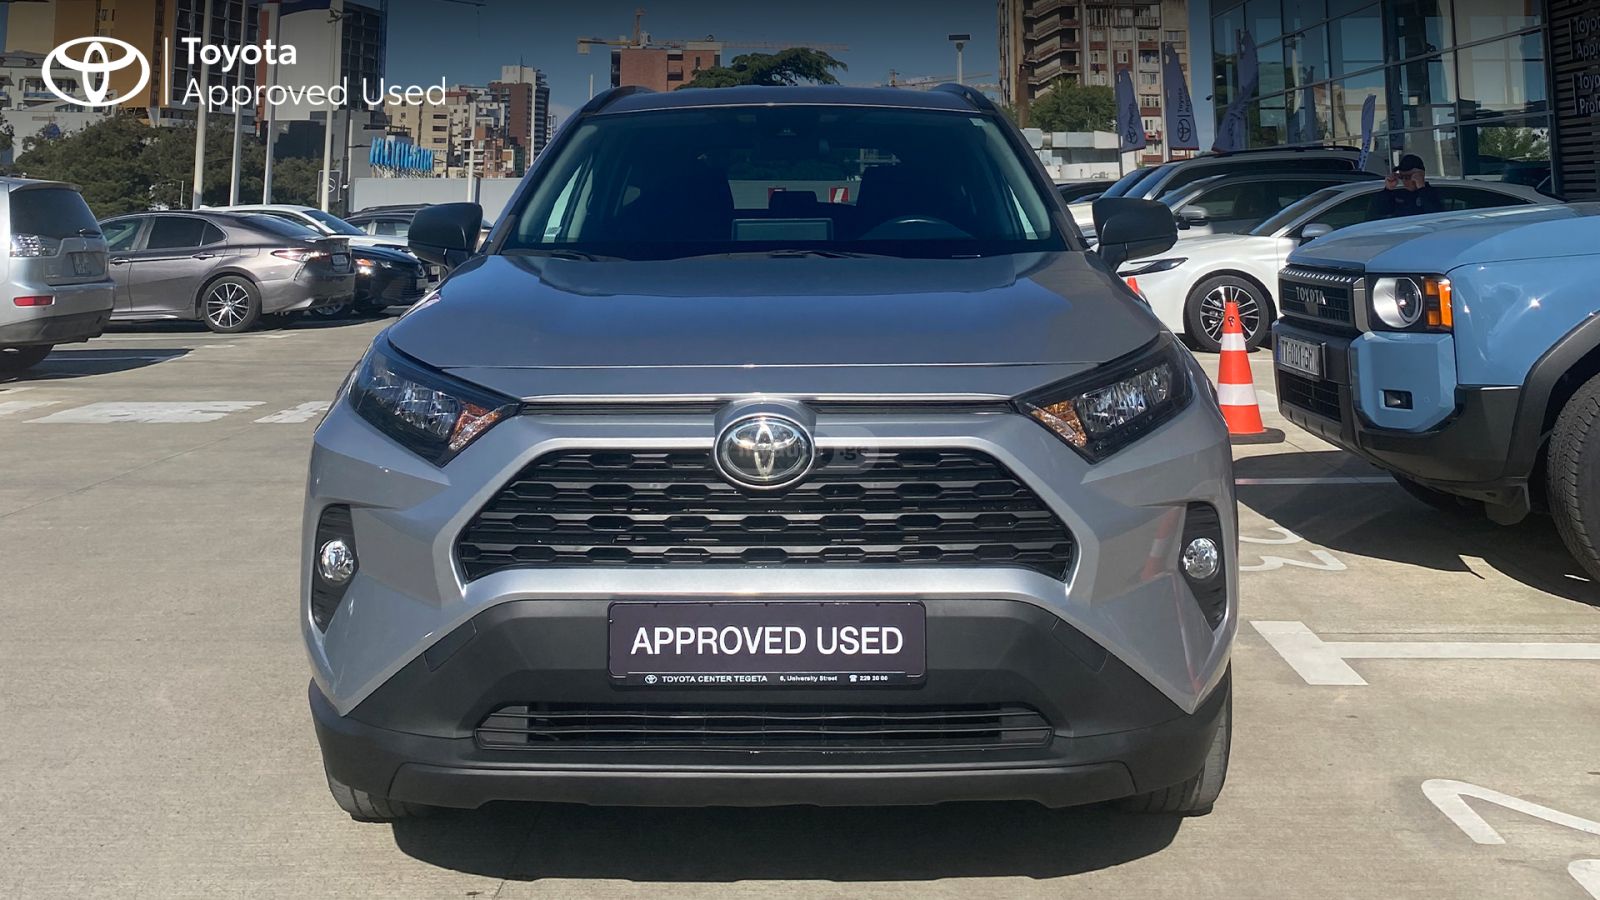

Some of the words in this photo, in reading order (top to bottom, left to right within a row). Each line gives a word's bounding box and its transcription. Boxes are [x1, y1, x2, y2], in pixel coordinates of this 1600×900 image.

[1296, 286, 1326, 305] TOYOTA
[630, 625, 807, 655] APPROVED
[816, 625, 903, 655] USED
[661, 675, 696, 683] TOYOTA
[697, 675, 732, 683] CENTER
[734, 675, 768, 683] TEGETA
[787, 675, 818, 683] University
